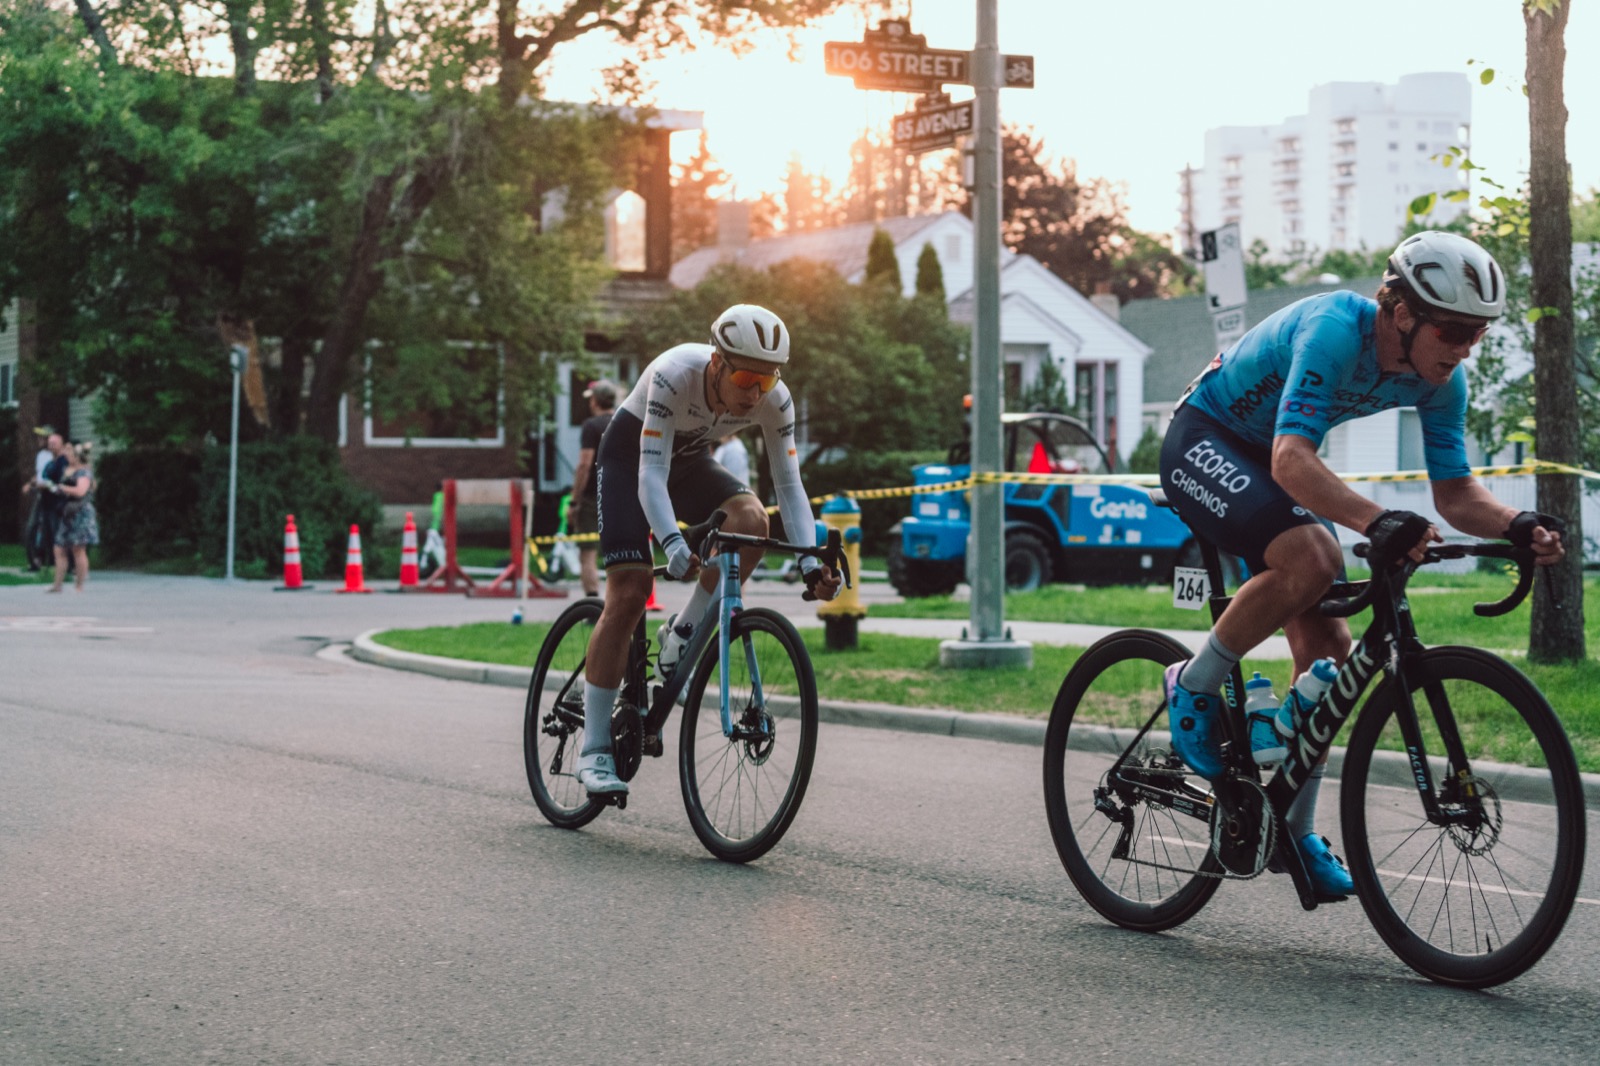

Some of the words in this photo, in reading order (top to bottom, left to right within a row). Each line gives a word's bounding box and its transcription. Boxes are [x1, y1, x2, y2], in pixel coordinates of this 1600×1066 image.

[830, 48, 873, 72] 106
[877, 51, 963, 77] STREET
[895, 119, 914, 141] 85
[914, 106, 970, 137] AVENUE
[1183, 440, 1251, 493] ECOFLO
[1090, 496, 1147, 519] Genie
[1170, 468, 1229, 518] CHRONOS
[1176, 576, 1204, 602] 264
[1281, 643, 1374, 791] FACTOR
[1408, 746, 1428, 790] FACTOR
